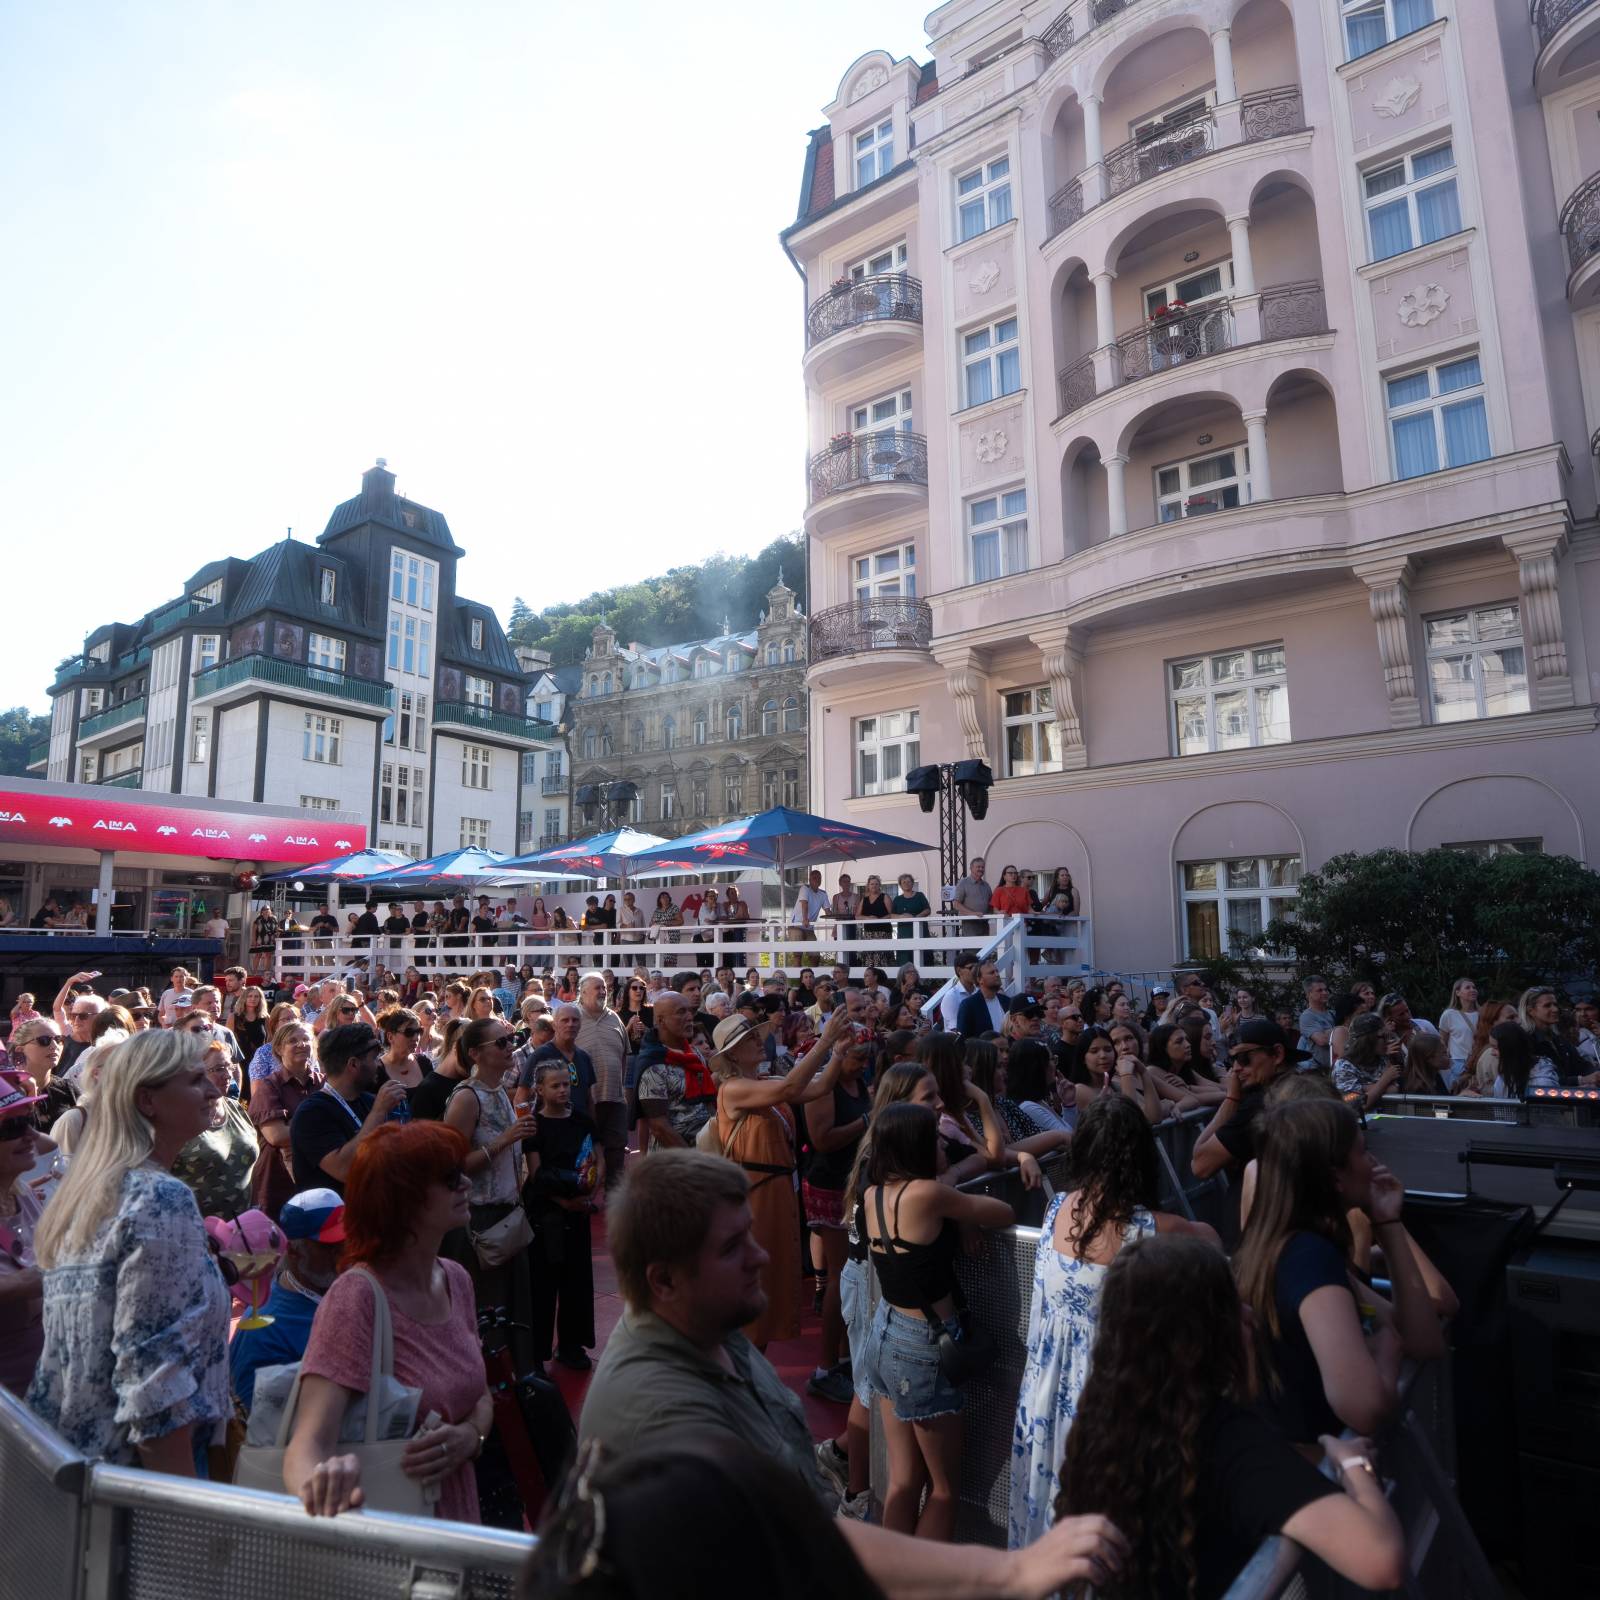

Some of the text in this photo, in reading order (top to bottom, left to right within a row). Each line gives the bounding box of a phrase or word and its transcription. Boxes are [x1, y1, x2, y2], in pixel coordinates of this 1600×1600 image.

[93, 819, 137, 832] ALMA
[192, 828, 230, 839] ALMA
[284, 836, 318, 846] ALMA
